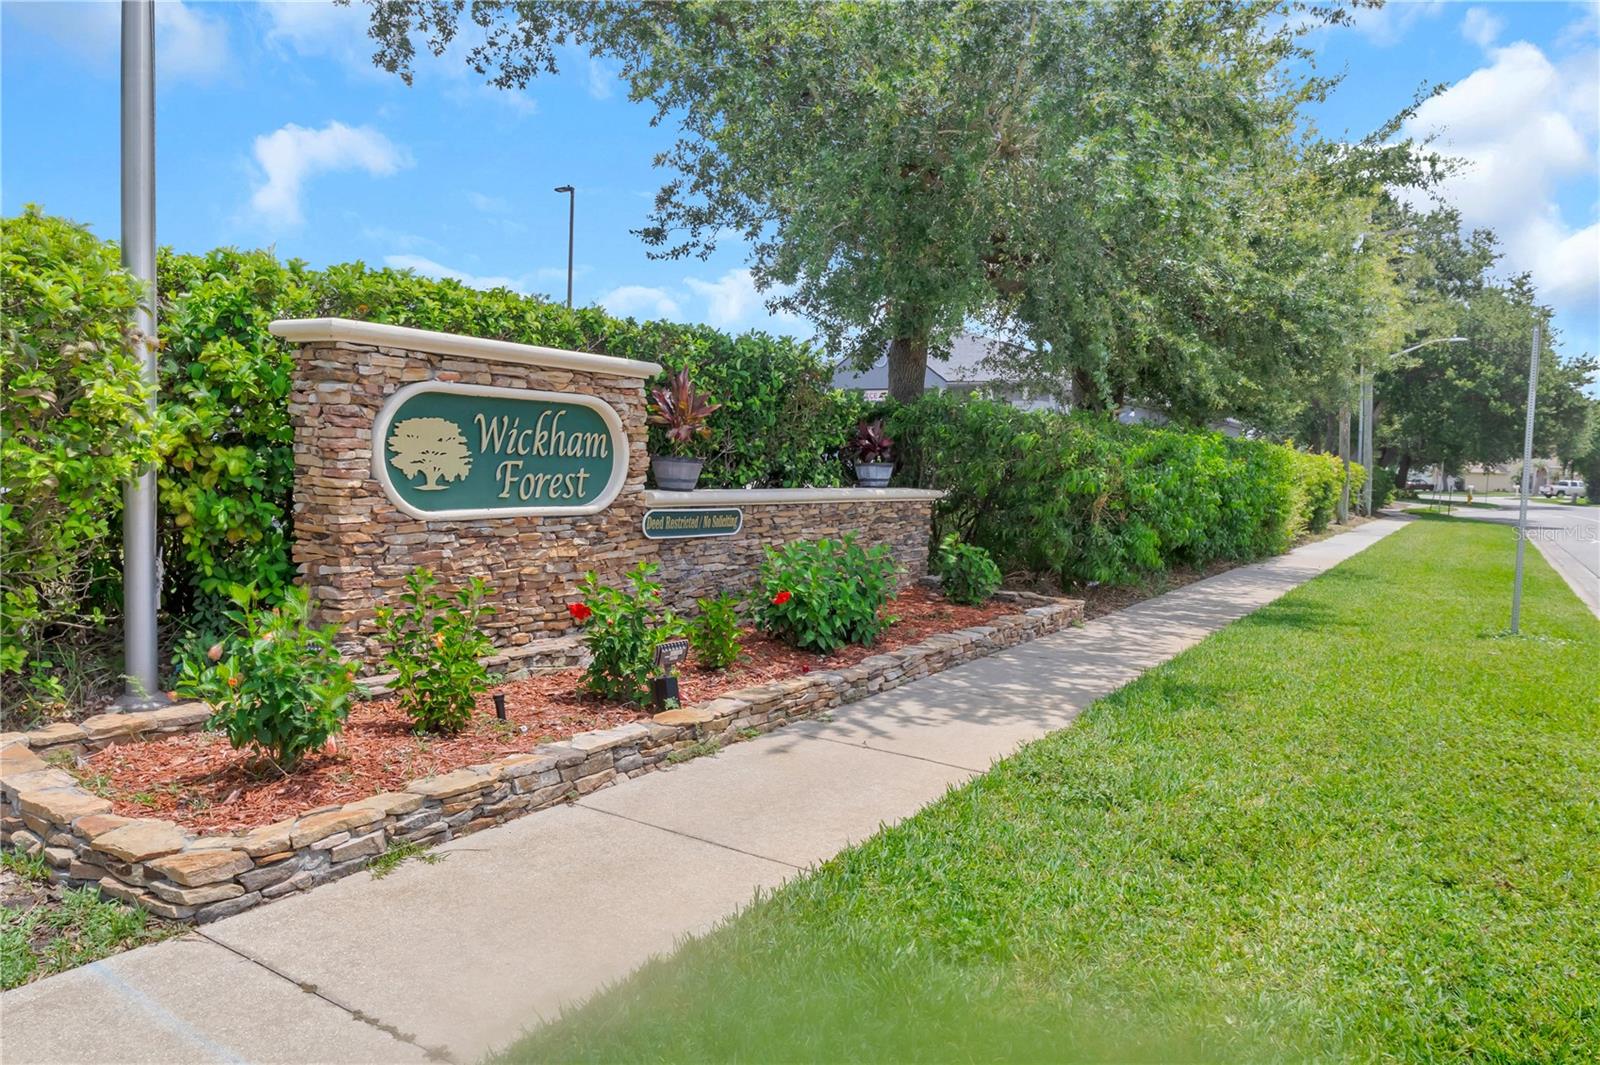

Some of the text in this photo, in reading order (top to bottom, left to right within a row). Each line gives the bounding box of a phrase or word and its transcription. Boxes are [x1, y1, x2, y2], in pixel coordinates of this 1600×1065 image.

[474, 410, 608, 458] Wickham
[496, 460, 590, 500] Forest
[646, 516, 663, 530] Deed
[666, 515, 699, 529] Restricted
[703, 514, 711, 528] No
[712, 514, 738, 529] Soliciting
